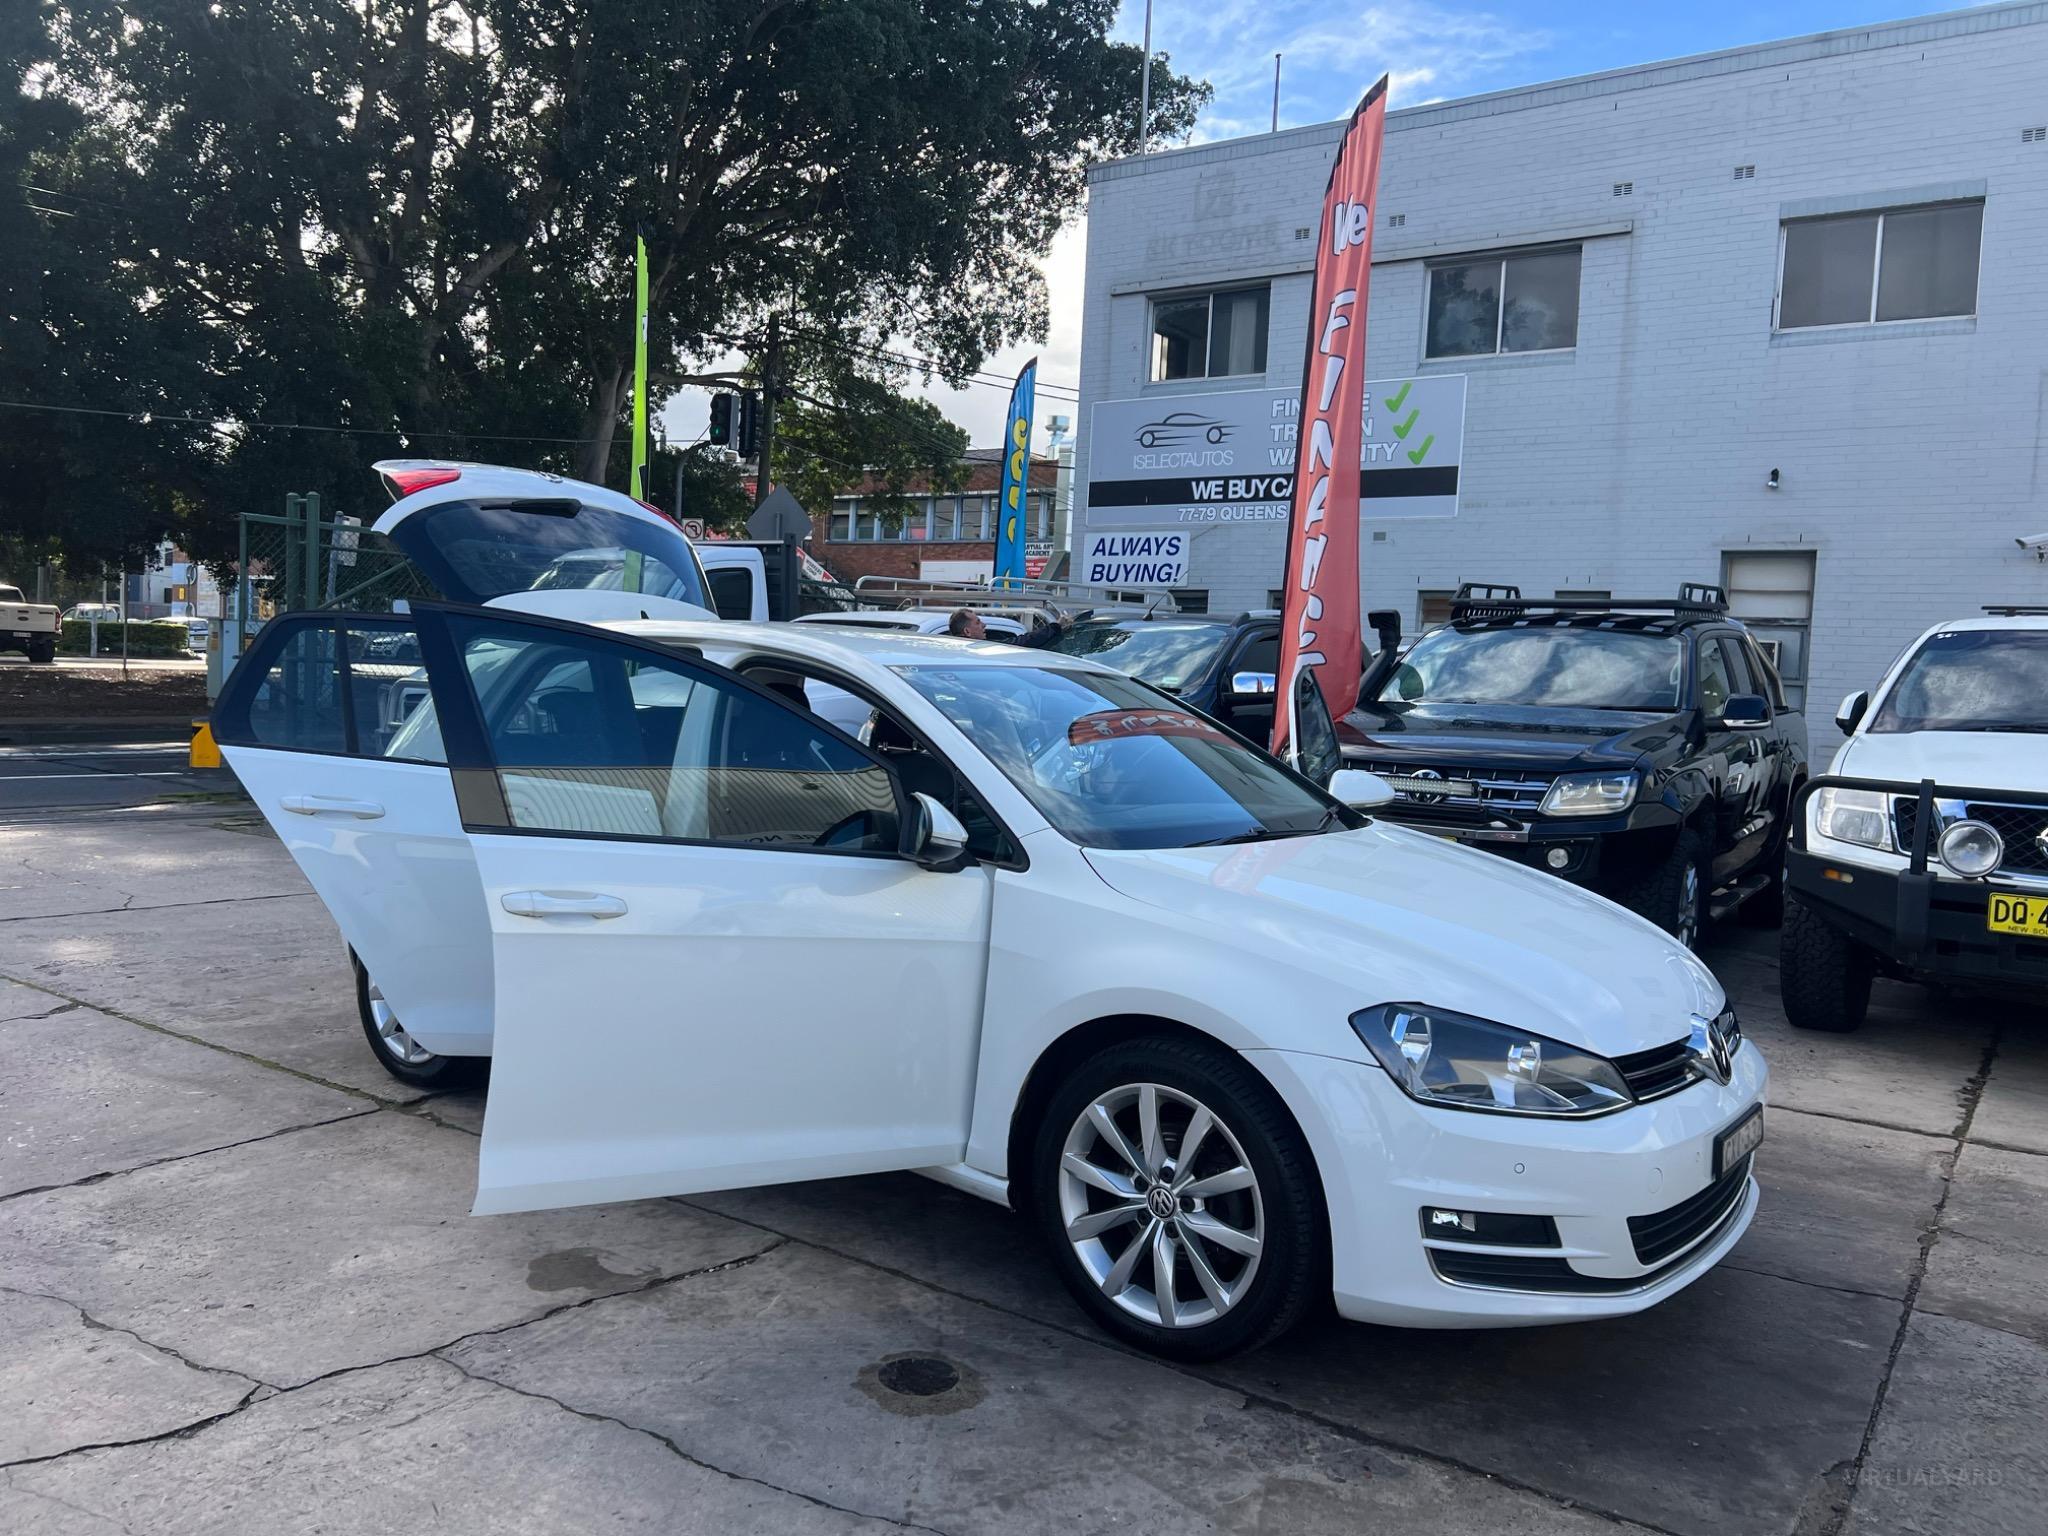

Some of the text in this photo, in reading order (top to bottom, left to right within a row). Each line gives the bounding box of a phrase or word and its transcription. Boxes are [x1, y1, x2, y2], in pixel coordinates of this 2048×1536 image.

[1191, 480, 1225, 500] WE
[1228, 478, 1271, 499] BUY
[1291, 287, 1357, 674] FINANC
[1177, 504, 1288, 522] 77-79 QUEENS
[1092, 536, 1182, 556] ALWAYS
[1090, 563, 1182, 583] BUYING!
